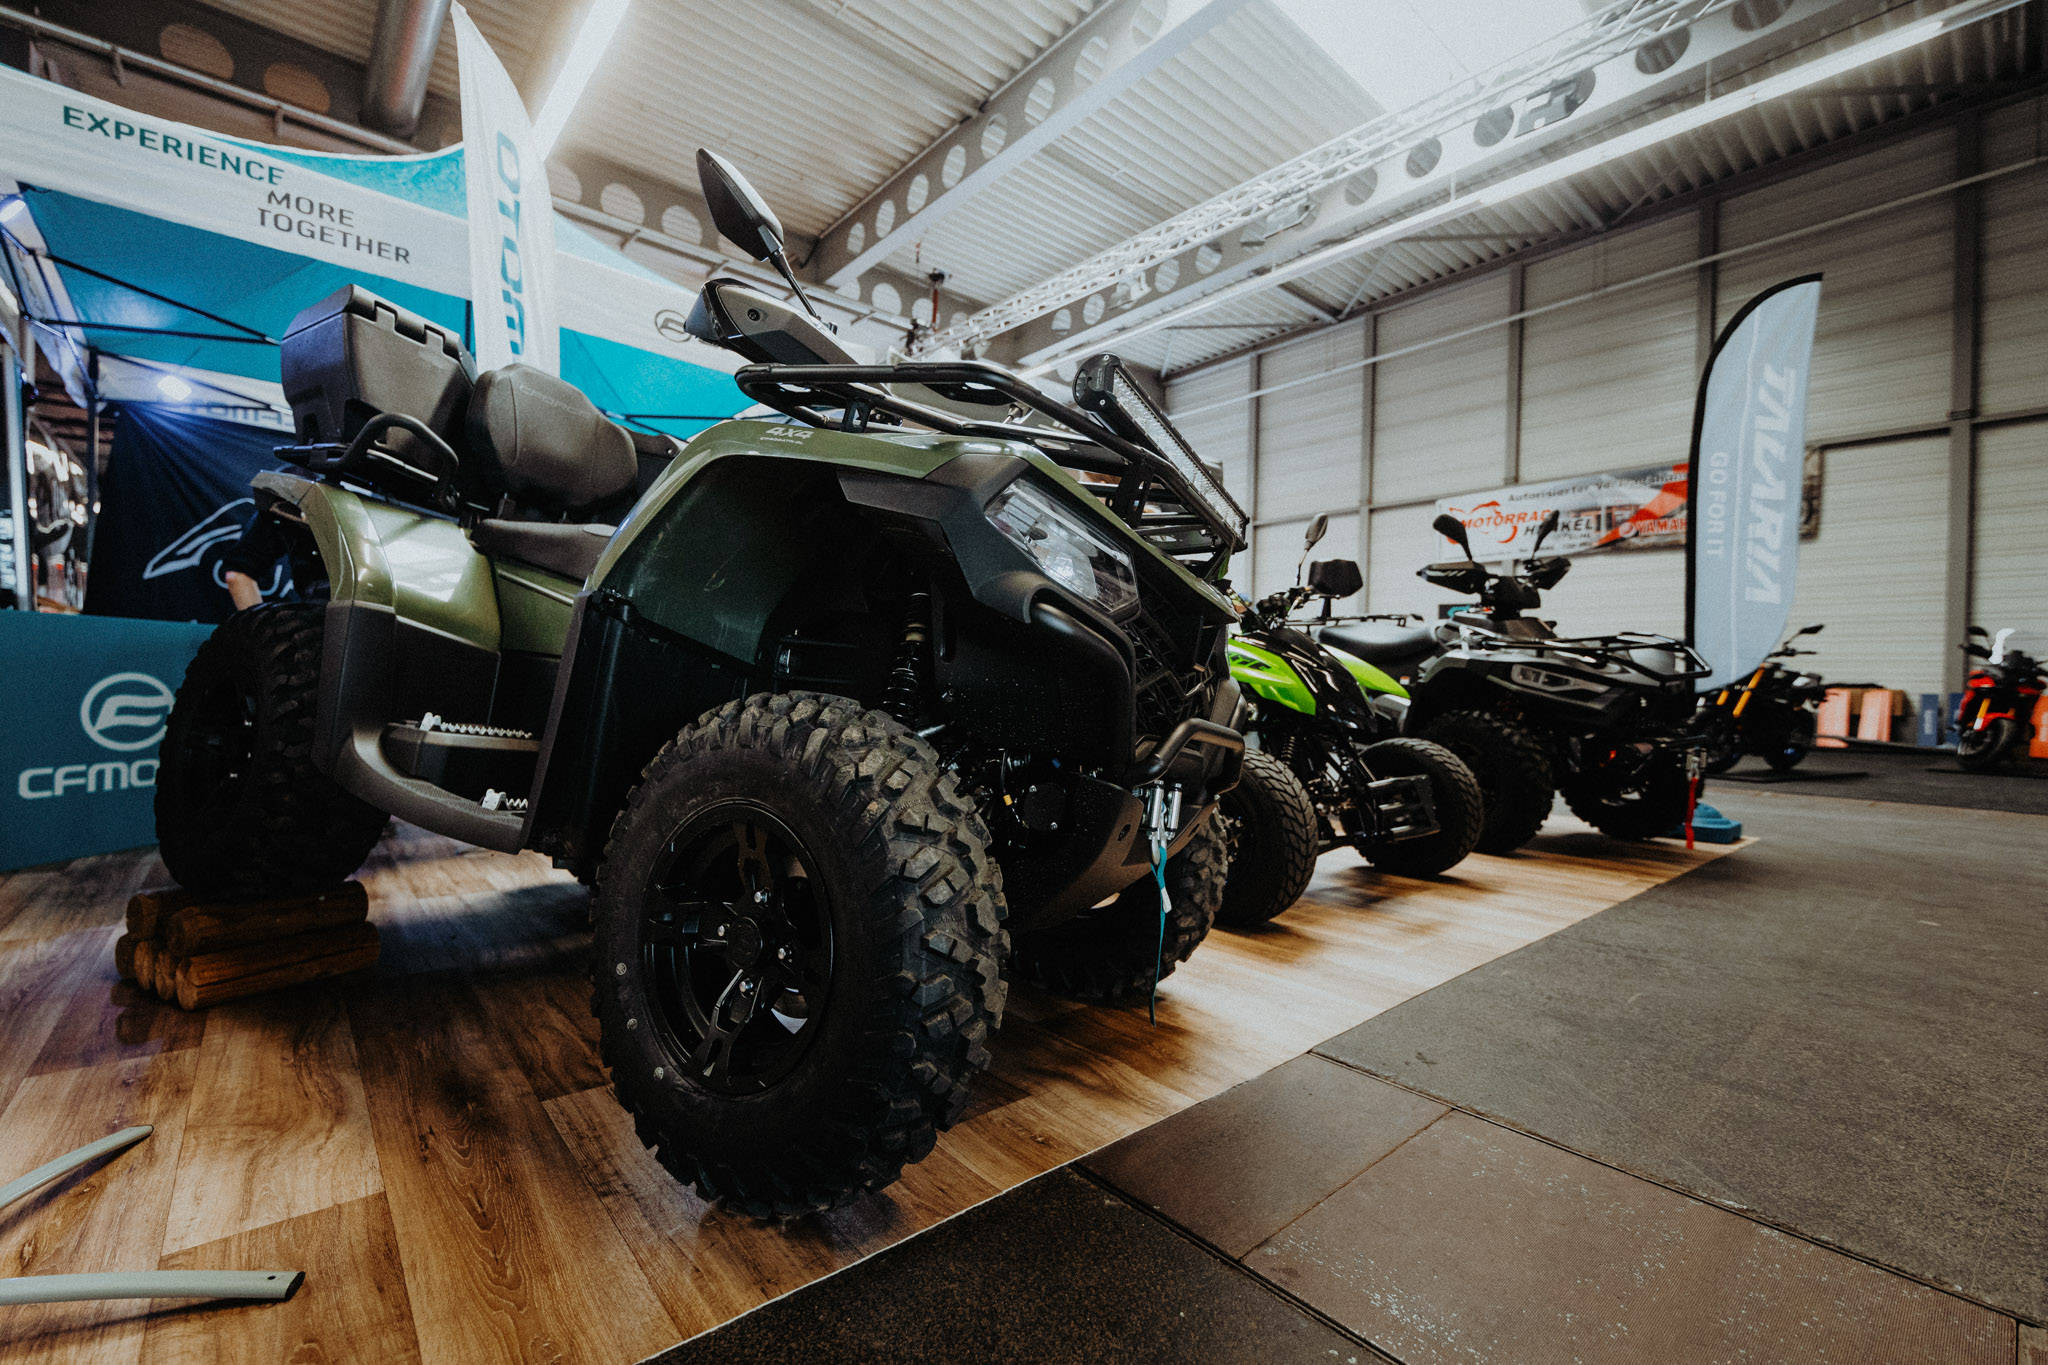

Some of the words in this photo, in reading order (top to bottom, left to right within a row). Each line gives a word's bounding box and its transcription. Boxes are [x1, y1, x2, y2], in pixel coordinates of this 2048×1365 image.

[63, 105, 285, 186] EXPERIENCE
[267, 190, 354, 228] MORE
[257, 207, 410, 264] TOGETHER
[1708, 452, 1729, 485] GO
[1744, 363, 1797, 604] TALARIA
[1635, 517, 1687, 535] YAMAH
[1706, 490, 1728, 533] FOR
[1706, 538, 1726, 559] IT
[18, 759, 161, 800] CFMO
